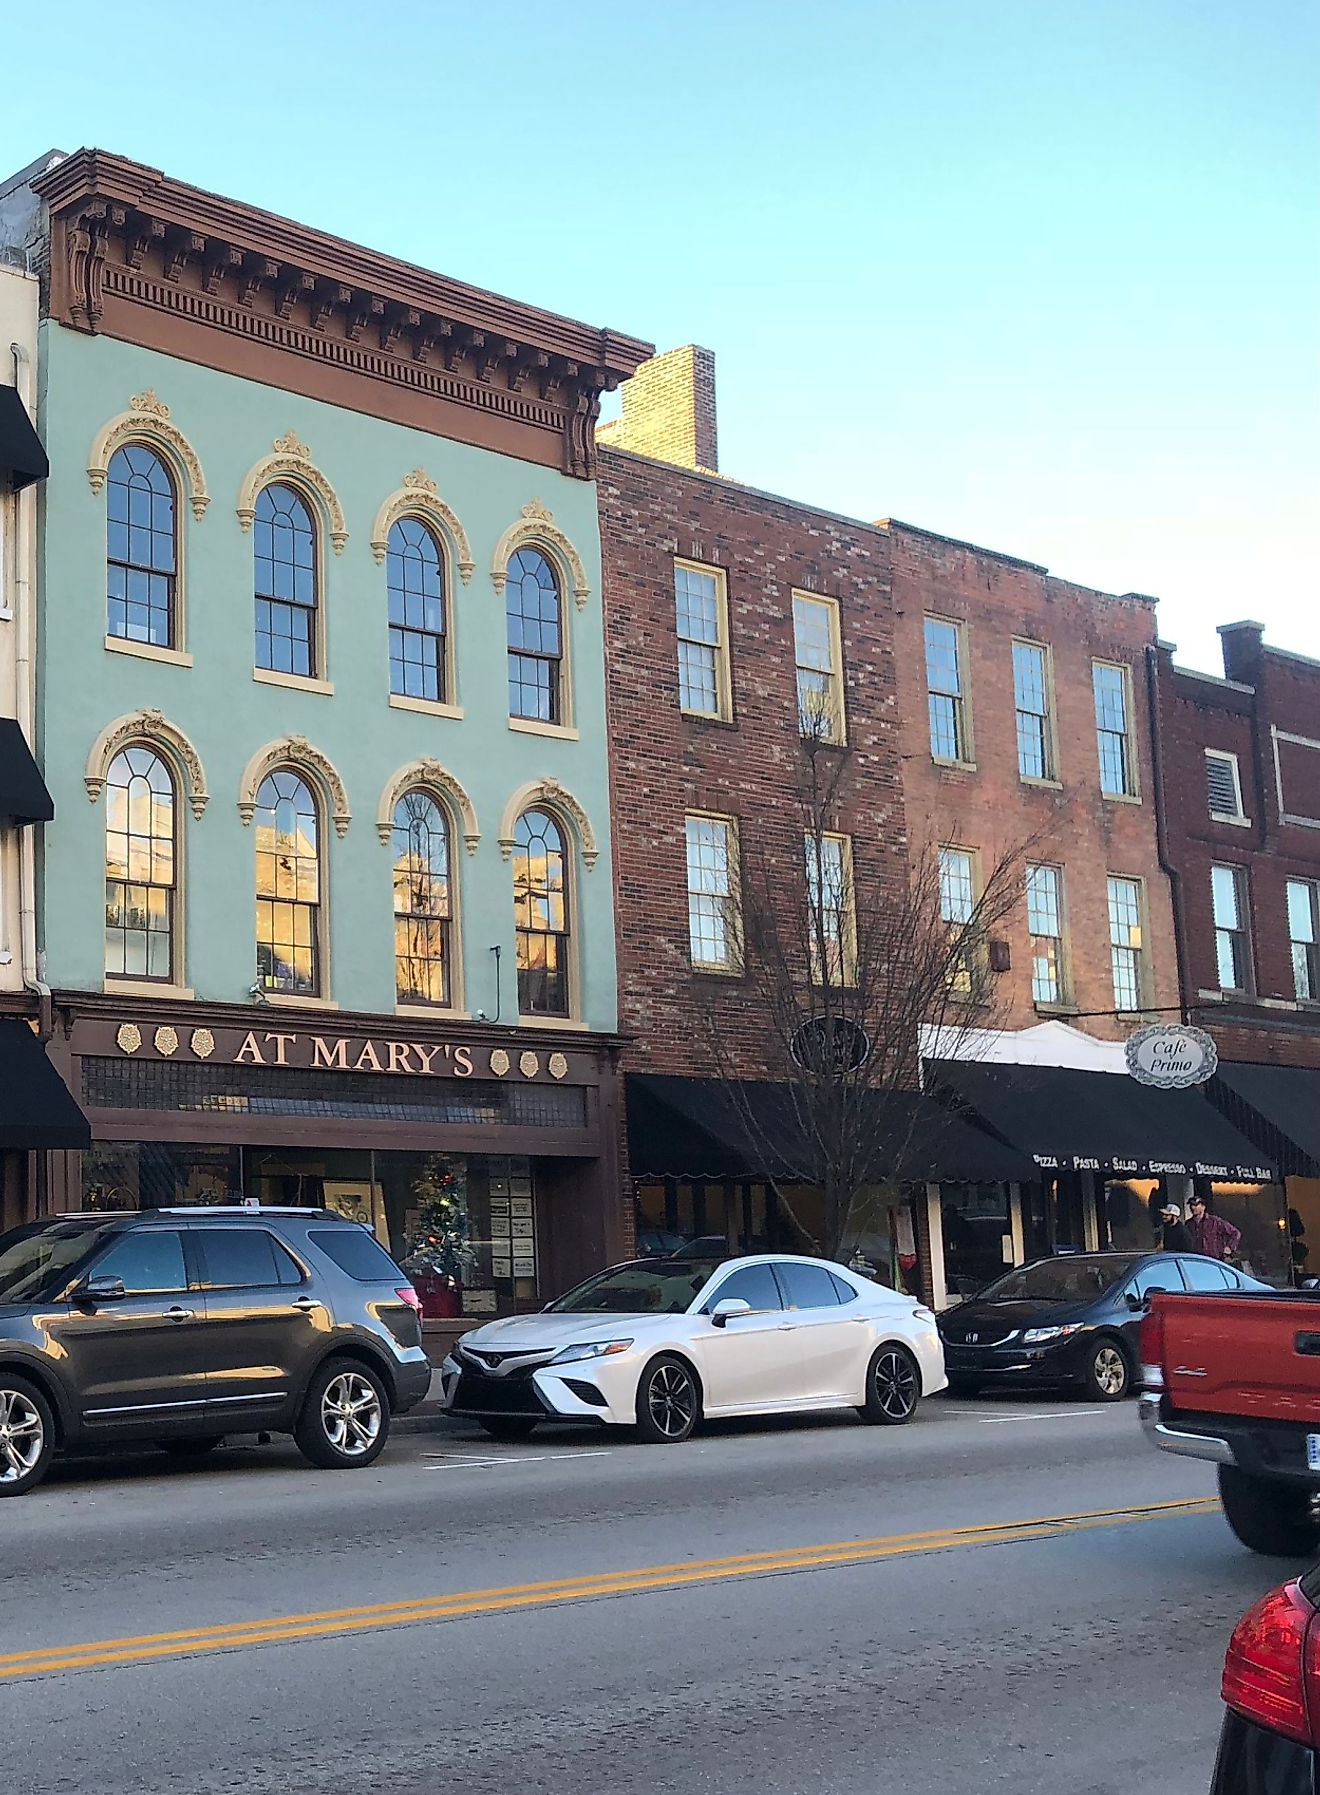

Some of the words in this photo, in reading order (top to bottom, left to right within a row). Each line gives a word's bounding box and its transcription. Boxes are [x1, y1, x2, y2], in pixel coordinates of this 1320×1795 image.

[232, 1031, 296, 1065] AT
[309, 1036, 473, 1077] MARY'S
[1152, 1038, 1187, 1059] Café
[1150, 1059, 1192, 1072] Primo
[1073, 1156, 1100, 1169] PASTA
[1112, 1157, 1138, 1171] SALAD
[1256, 1166, 1271, 1179] BAR
